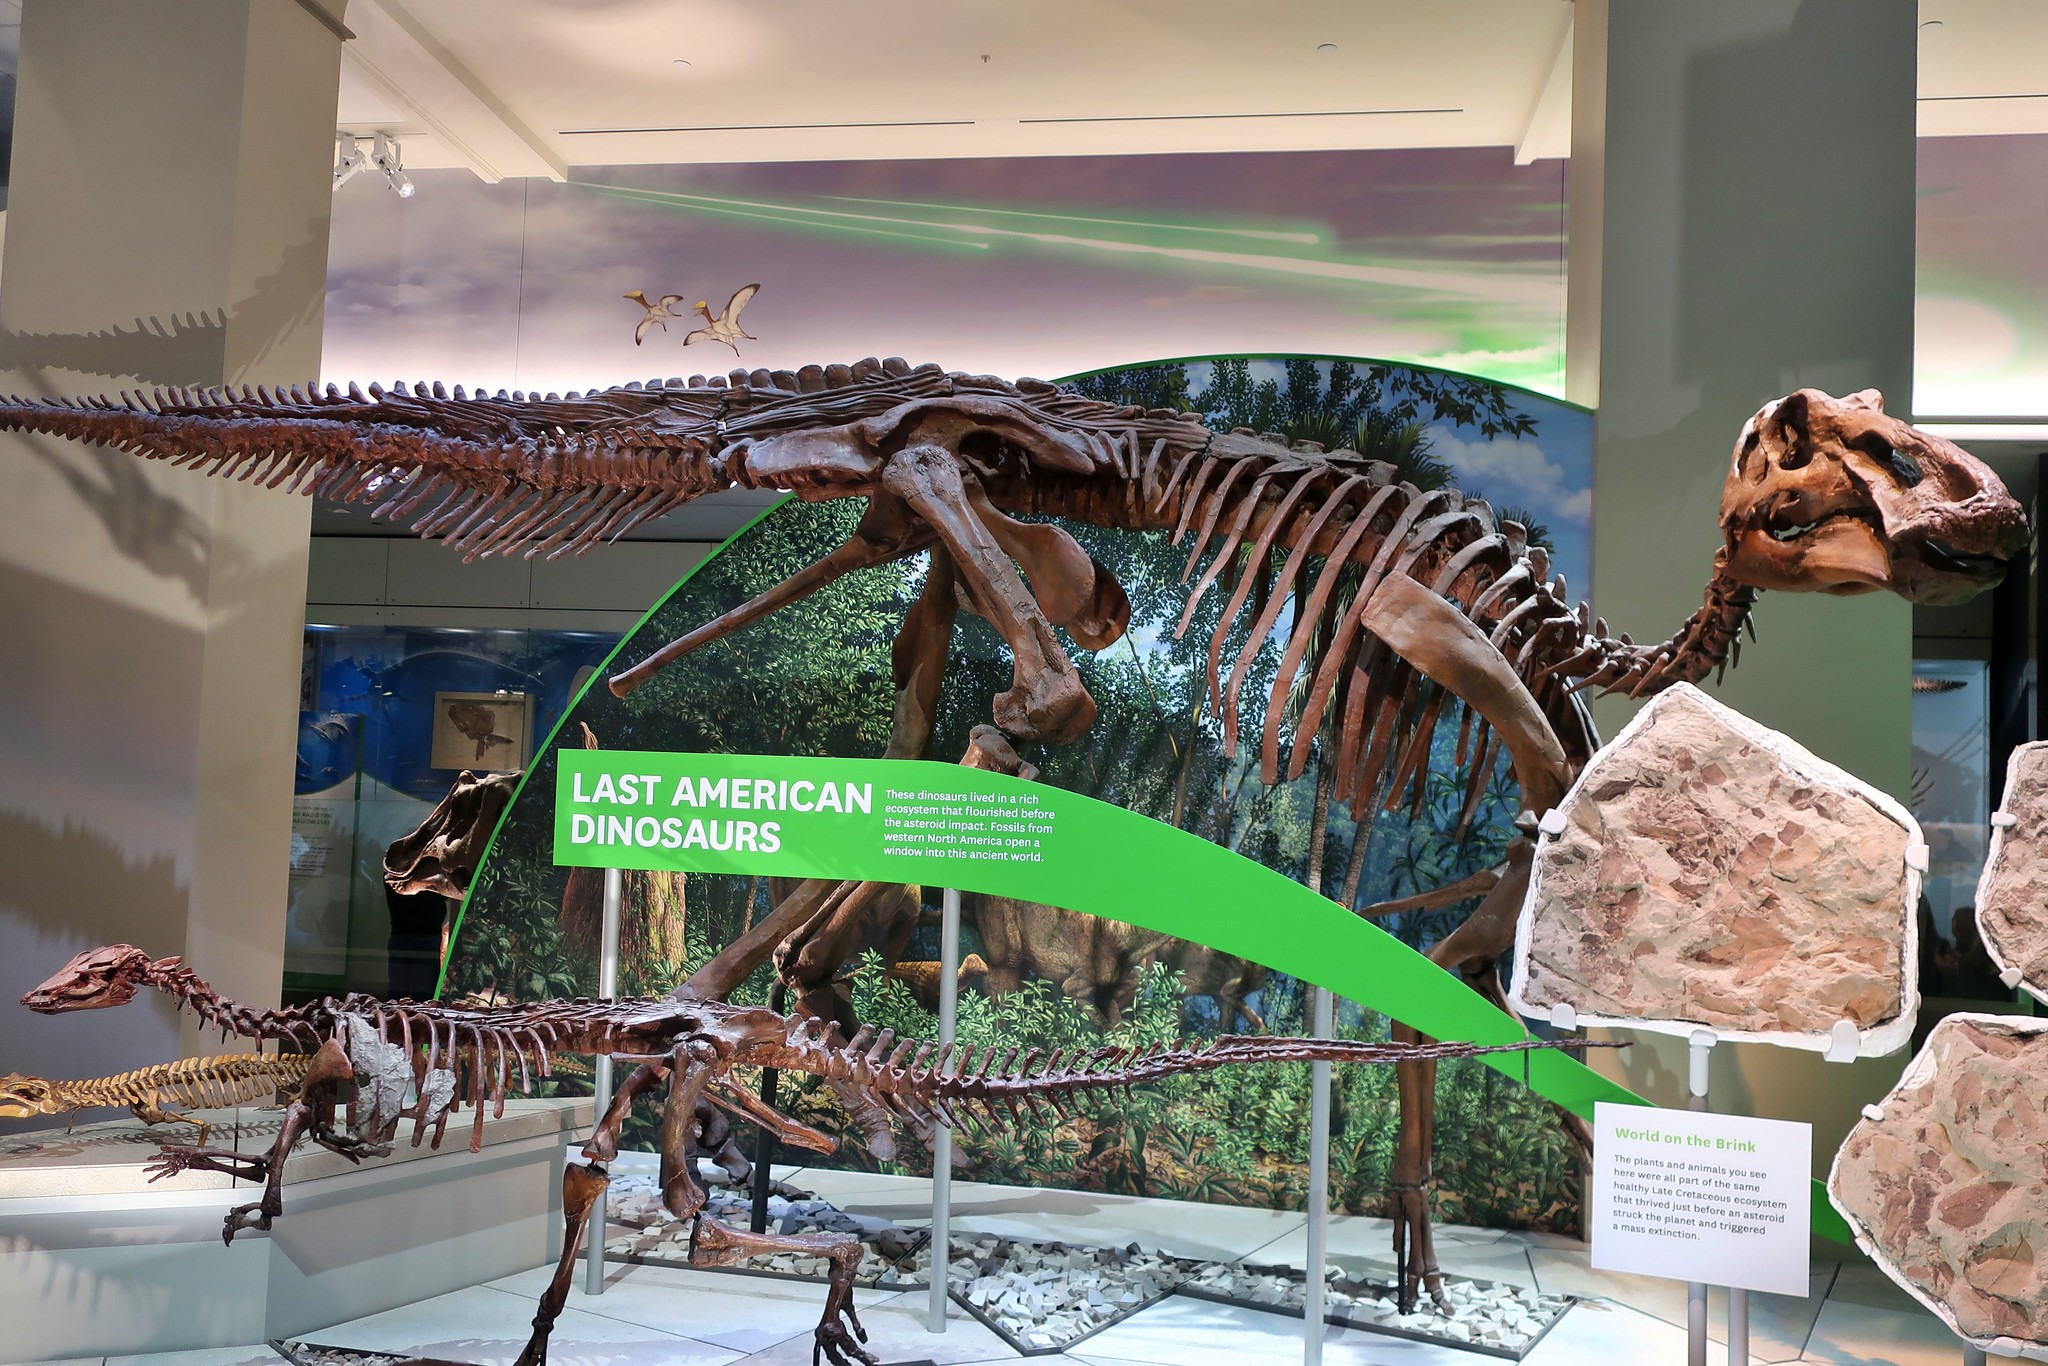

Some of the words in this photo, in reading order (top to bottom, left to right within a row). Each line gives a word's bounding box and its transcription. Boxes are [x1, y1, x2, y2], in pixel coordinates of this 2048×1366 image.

[573, 773, 662, 805] LAST
[671, 777, 872, 814] AMERICAN
[885, 788, 916, 801] These
[916, 789, 968, 803] dinosaurs
[969, 791, 996, 803] lived
[998, 793, 1007, 803] in
[1018, 793, 1040, 805] rich
[884, 804, 940, 815] ecosystem
[940, 804, 963, 816] that
[964, 805, 1019, 819] flourished
[1020, 807, 1056, 820] before
[571, 814, 781, 853] DINOSAURS
[883, 816, 902, 828] the
[903, 818, 946, 830] asteroid
[948, 818, 988, 832] impact.
[990, 821, 1026, 833] Fossils
[1027, 821, 1054, 834] from
[883, 832, 925, 843] western
[927, 833, 958, 845] North
[958, 834, 1003, 847] America
[1004, 838, 1032, 849] open
[882, 844, 924, 857] window
[924, 846, 946, 858] into
[947, 847, 968, 859] this
[968, 848, 1009, 861] ancient
[1010, 851, 1045, 863] world.
[1615, 1128, 1659, 1142] World
[1664, 1135, 1682, 1144] on
[1686, 1135, 1711, 1148] the
[1716, 1138, 1756, 1152] Brink
[1614, 1153, 1632, 1165] The
[1633, 1156, 1665, 1168] plants
[1666, 1161, 1686, 1171] and
[1687, 1163, 1727, 1176] animals
[1728, 1168, 1748, 1178] you
[1749, 1170, 1768, 1180] see
[1613, 1167, 1636, 1179] here
[1637, 1172, 1662, 1182] were
[1663, 1173, 1676, 1183] all
[1678, 1176, 1700, 1186] part
[1702, 1178, 1712, 1186] of
[1713, 1178, 1732, 1190] the
[1733, 1182, 1761, 1193] same
[1613, 1180, 1650, 1196] healthy
[1651, 1185, 1674, 1197] Late
[1675, 1188, 1732, 1204] Cretaceous
[1733, 1196, 1788, 1210] ecosystem
[1612, 1194, 1633, 1205] that
[1635, 1197, 1671, 1210] thrived
[1671, 1201, 1692, 1213] just
[1693, 1203, 1727, 1217] before
[1742, 1211, 1785, 1224] asteroid
[1612, 1208, 1644, 1220] struck
[1645, 1212, 1662, 1223] the
[1663, 1214, 1697, 1227] planet
[1697, 1219, 1718, 1230] and
[1719, 1221, 1766, 1236] triggered
[1620, 1224, 1647, 1234] mass
[1647, 1227, 1701, 1241] extinction.
